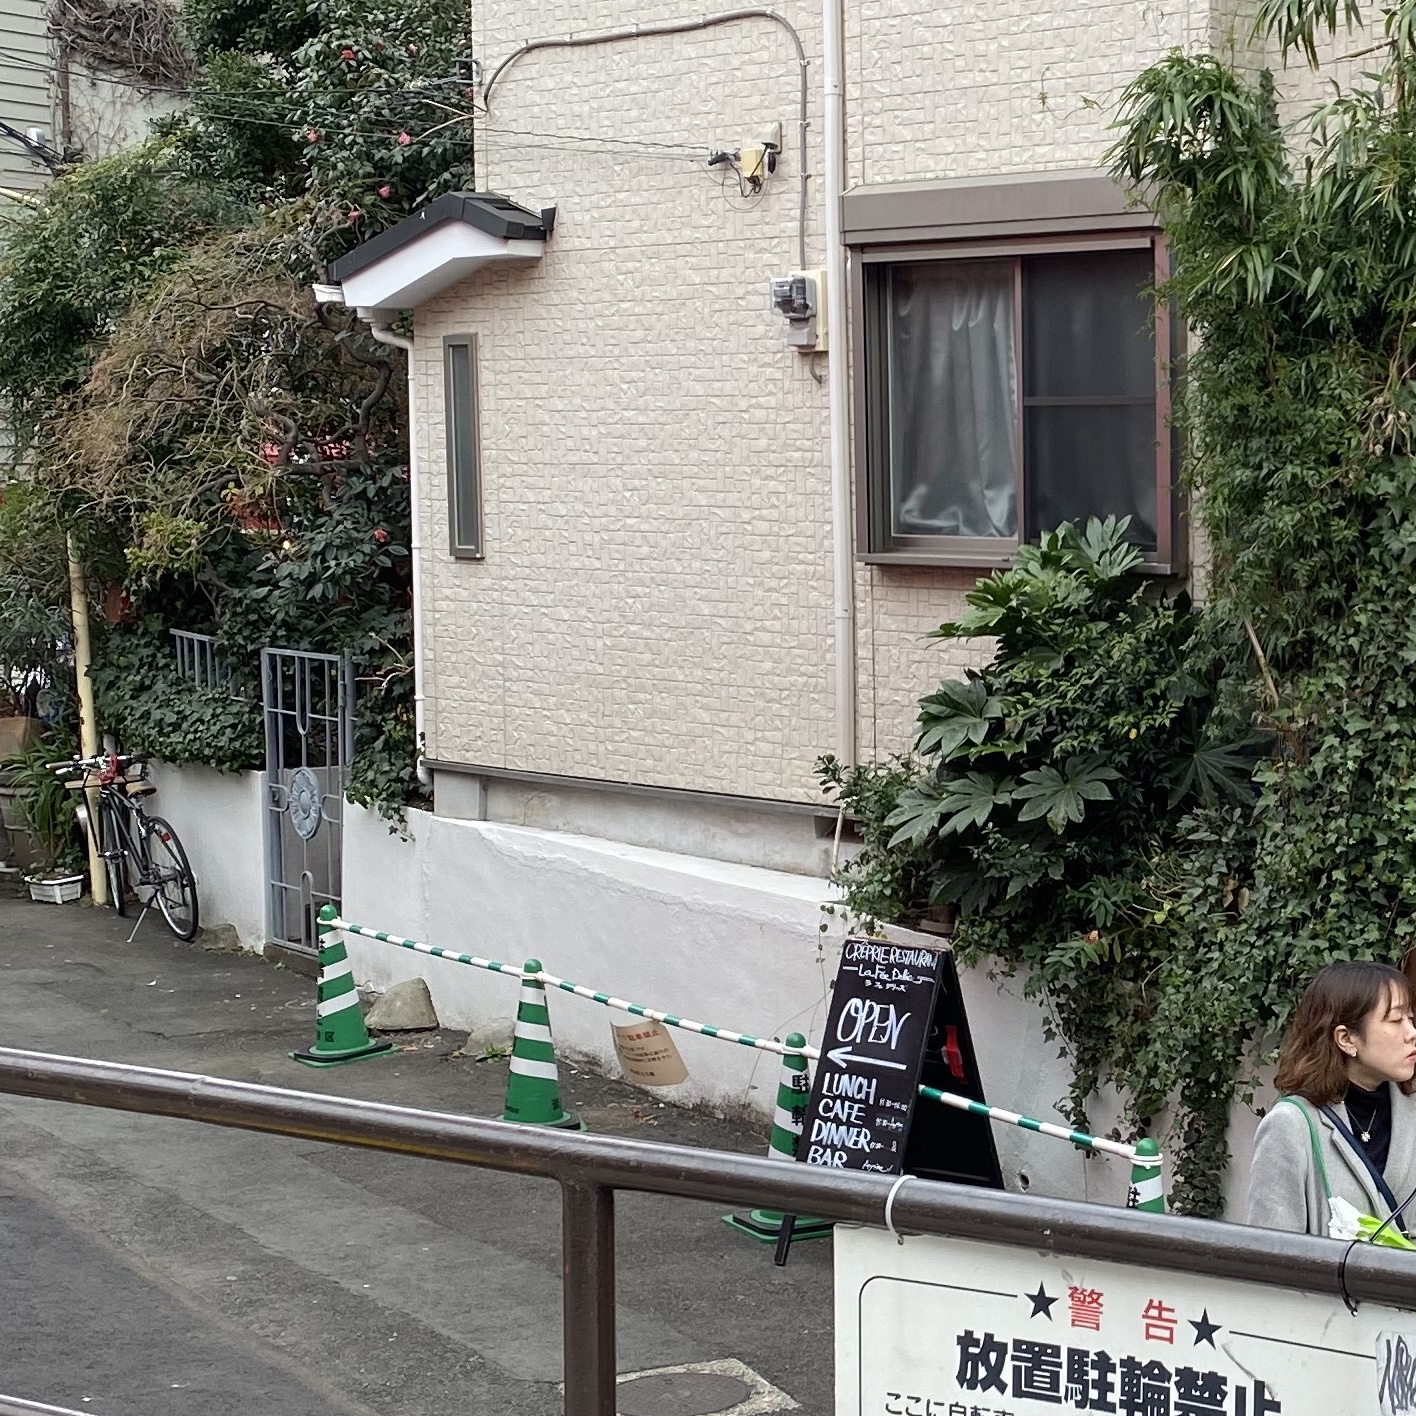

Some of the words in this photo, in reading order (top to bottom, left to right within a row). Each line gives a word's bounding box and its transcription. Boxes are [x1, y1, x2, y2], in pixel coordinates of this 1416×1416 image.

[837, 997, 911, 1050] OPEN
[822, 1072, 877, 1105] LUNCH
[818, 1098, 866, 1124] CAFE
[810, 1118, 870, 1152] DINNER
[807, 1145, 847, 1168] BAR
[1068, 1286, 1178, 1345] 警告
